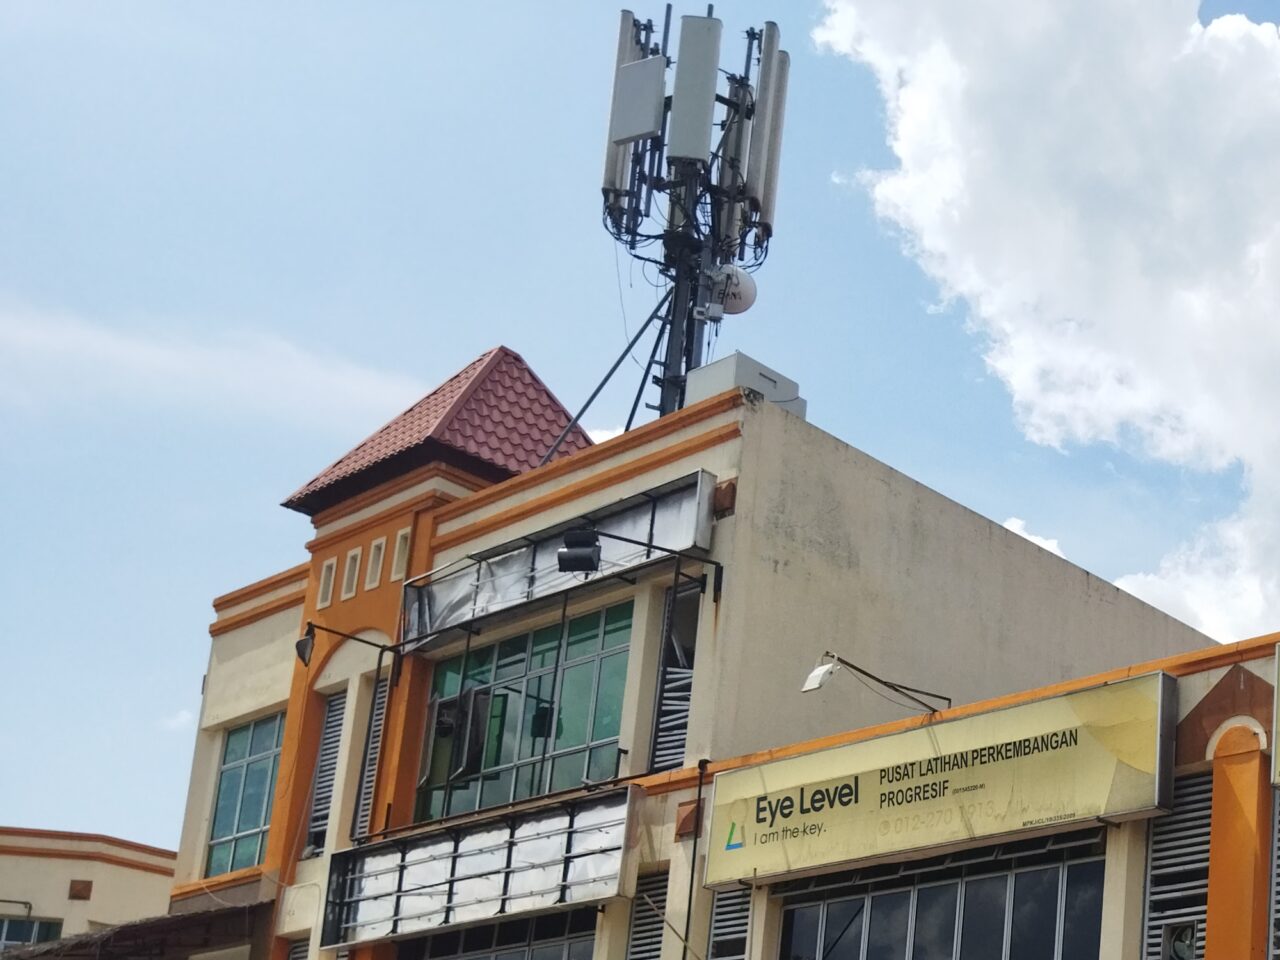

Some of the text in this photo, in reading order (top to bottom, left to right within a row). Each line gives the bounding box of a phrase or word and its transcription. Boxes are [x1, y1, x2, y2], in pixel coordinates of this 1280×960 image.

[879, 728, 1078, 785] PUSAT LATIHAN PERKEMBANGAN
[756, 775, 859, 828] Eye Level
[879, 780, 949, 809] PROGRESIF
[759, 831, 779, 845] am
[781, 826, 800, 840] the
[802, 822, 827, 837] key.
